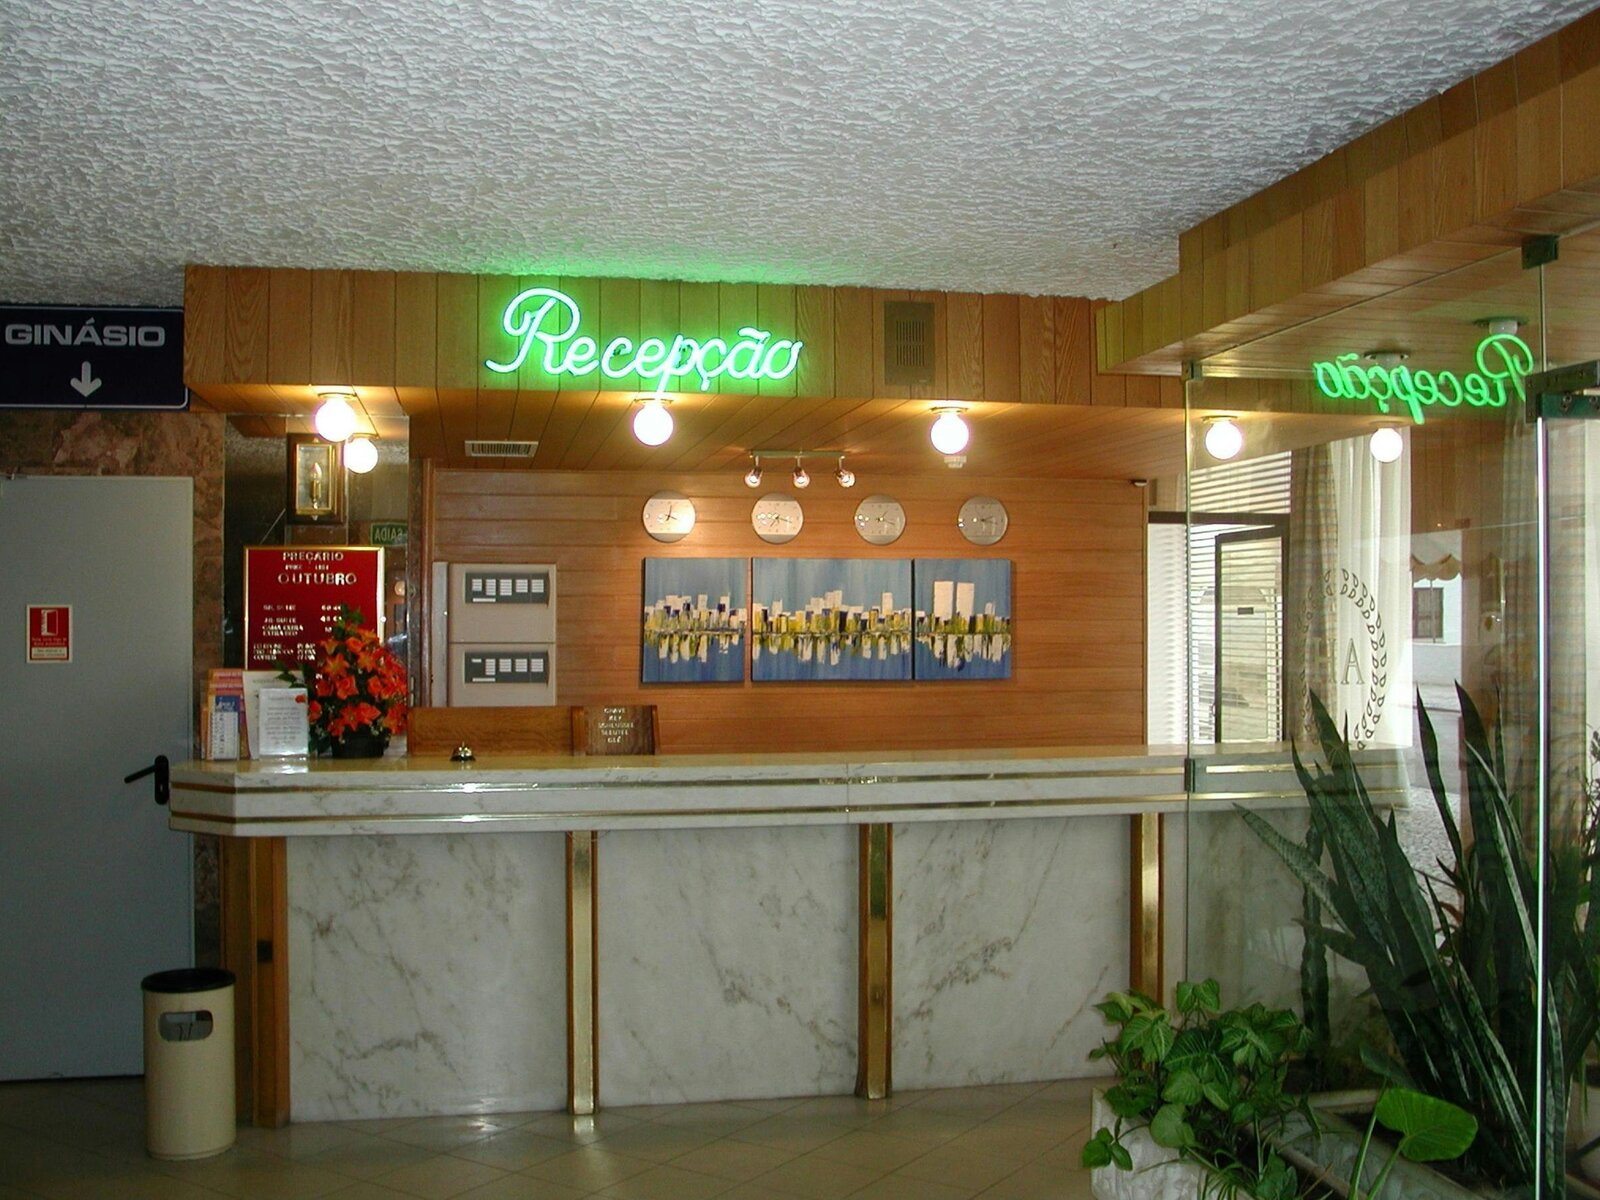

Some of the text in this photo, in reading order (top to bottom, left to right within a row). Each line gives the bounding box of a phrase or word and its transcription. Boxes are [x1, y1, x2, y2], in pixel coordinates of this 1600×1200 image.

[4, 316, 167, 348] GINÁSIO
[484, 286, 804, 399] Recepção
[277, 572, 358, 586] OUTUBRO
